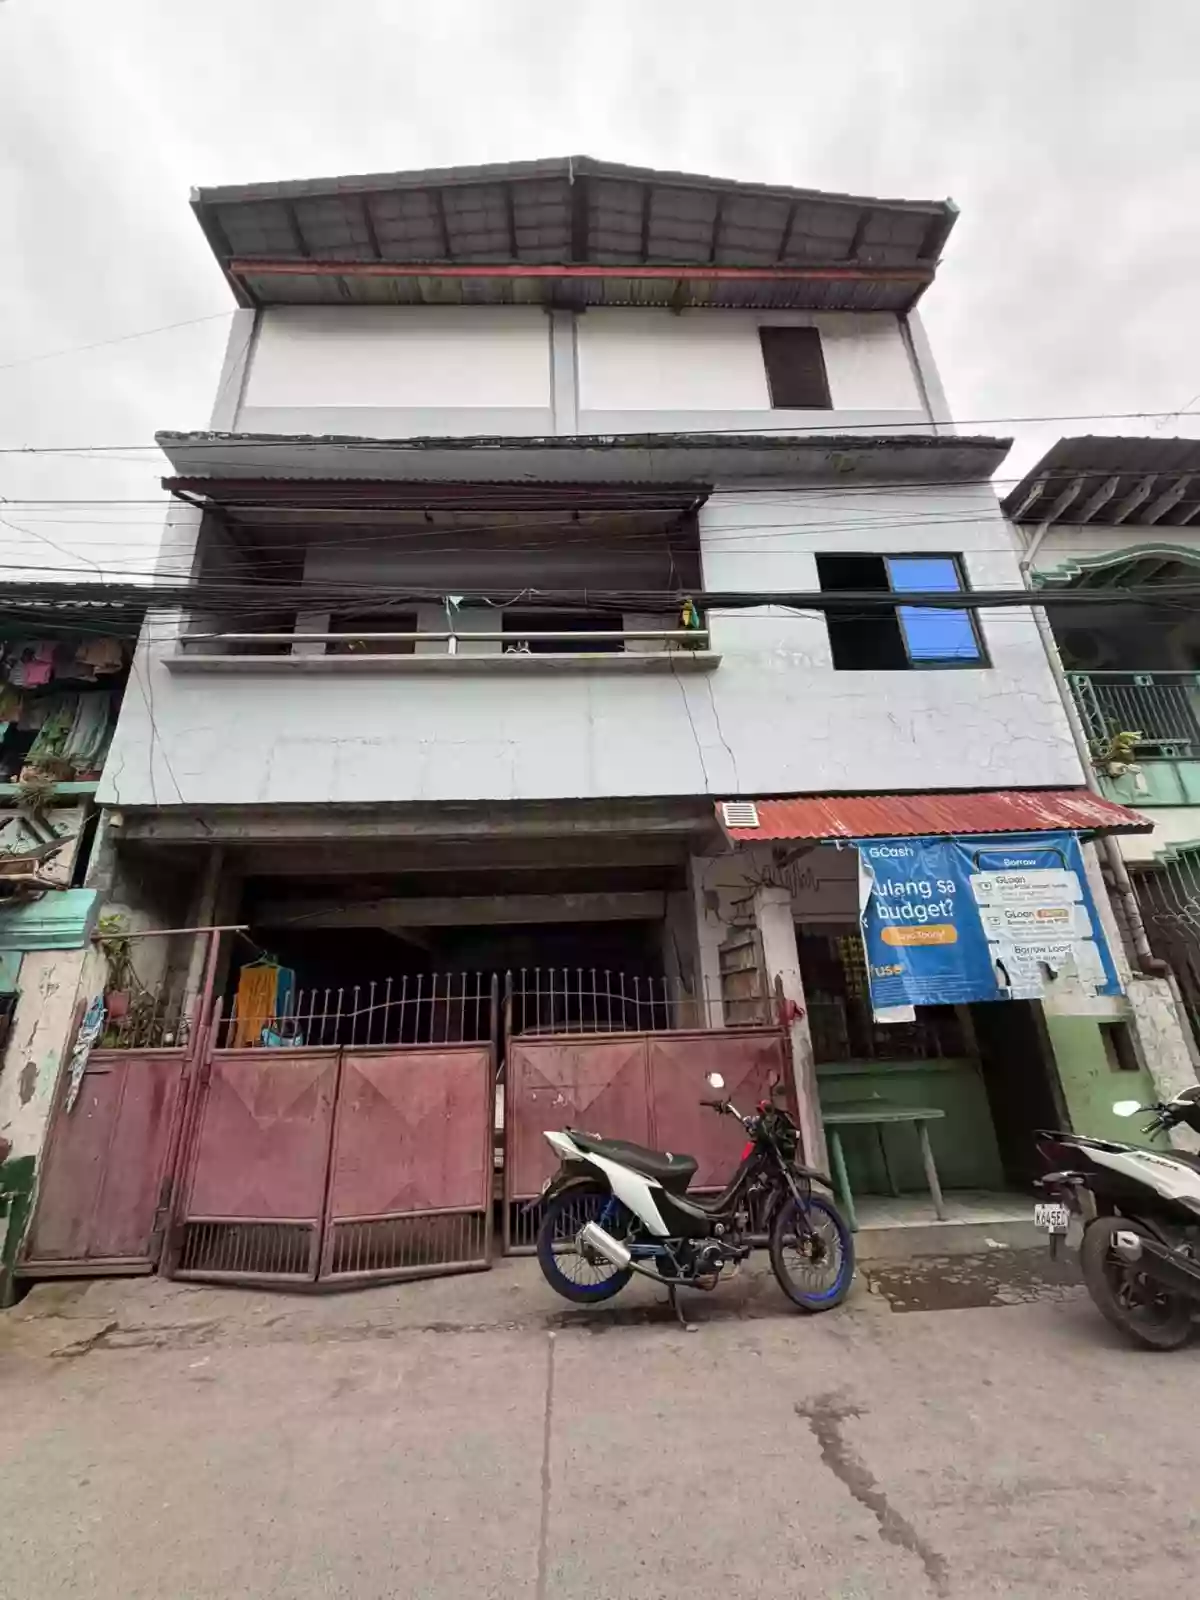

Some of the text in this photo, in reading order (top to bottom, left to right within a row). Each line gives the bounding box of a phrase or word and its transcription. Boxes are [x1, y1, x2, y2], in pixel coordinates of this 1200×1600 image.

[869, 845, 914, 858] GCash
[1003, 858, 1037, 867] Borrow
[937, 879, 956, 893] sa
[876, 899, 954, 922] budget?
